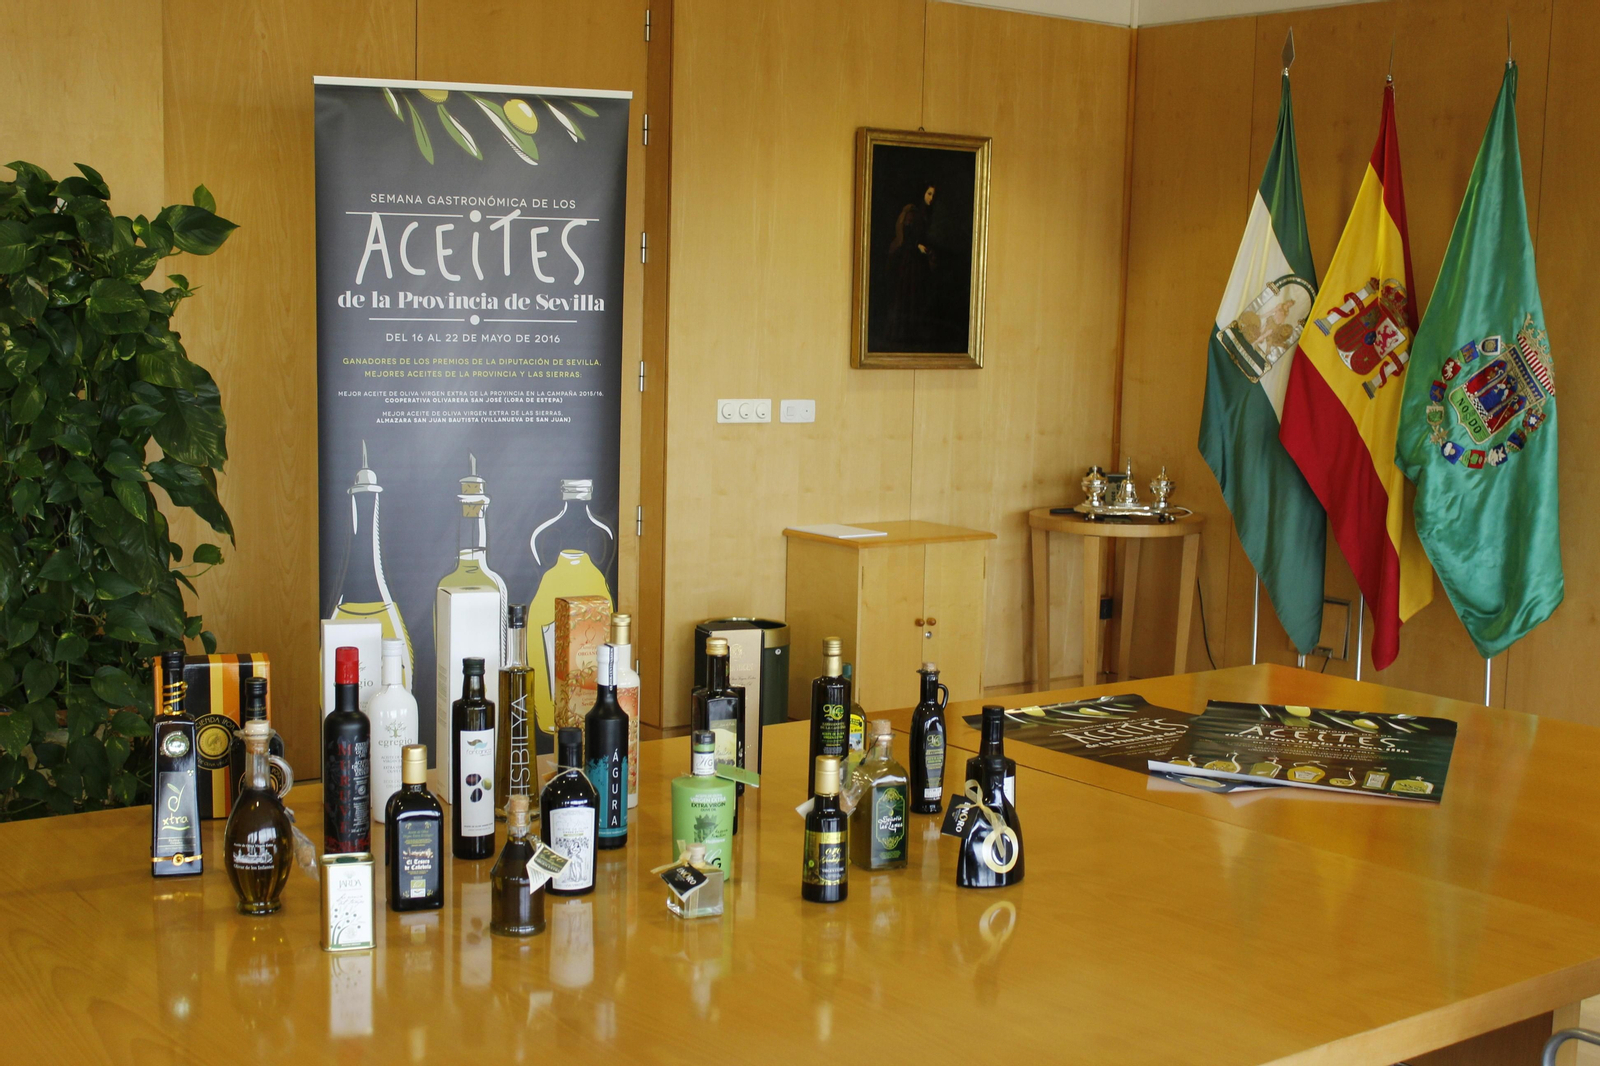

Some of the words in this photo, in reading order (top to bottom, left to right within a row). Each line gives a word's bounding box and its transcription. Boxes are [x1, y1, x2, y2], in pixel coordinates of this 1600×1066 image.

[370, 194, 422, 204] SEMANA
[428, 196, 527, 208] GASTRONÓMICA
[532, 199, 548, 208] DE
[554, 199, 576, 209] LOS
[338, 290, 365, 308] de
[372, 291, 390, 308] la
[397, 292, 498, 309] Provincia
[504, 293, 530, 310] de
[536, 294, 604, 311] Sevilla
[386, 333, 408, 342] DEL
[412, 333, 423, 342] 16
[427, 334, 441, 342] AL
[446, 334, 458, 342] 22
[462, 334, 477, 342] DE
[481, 334, 511, 342] MAYO
[516, 335, 530, 343] DE
[534, 335, 561, 343] 2016
[378, 738, 412, 747] egregio
[162, 812, 188, 826] xtra
